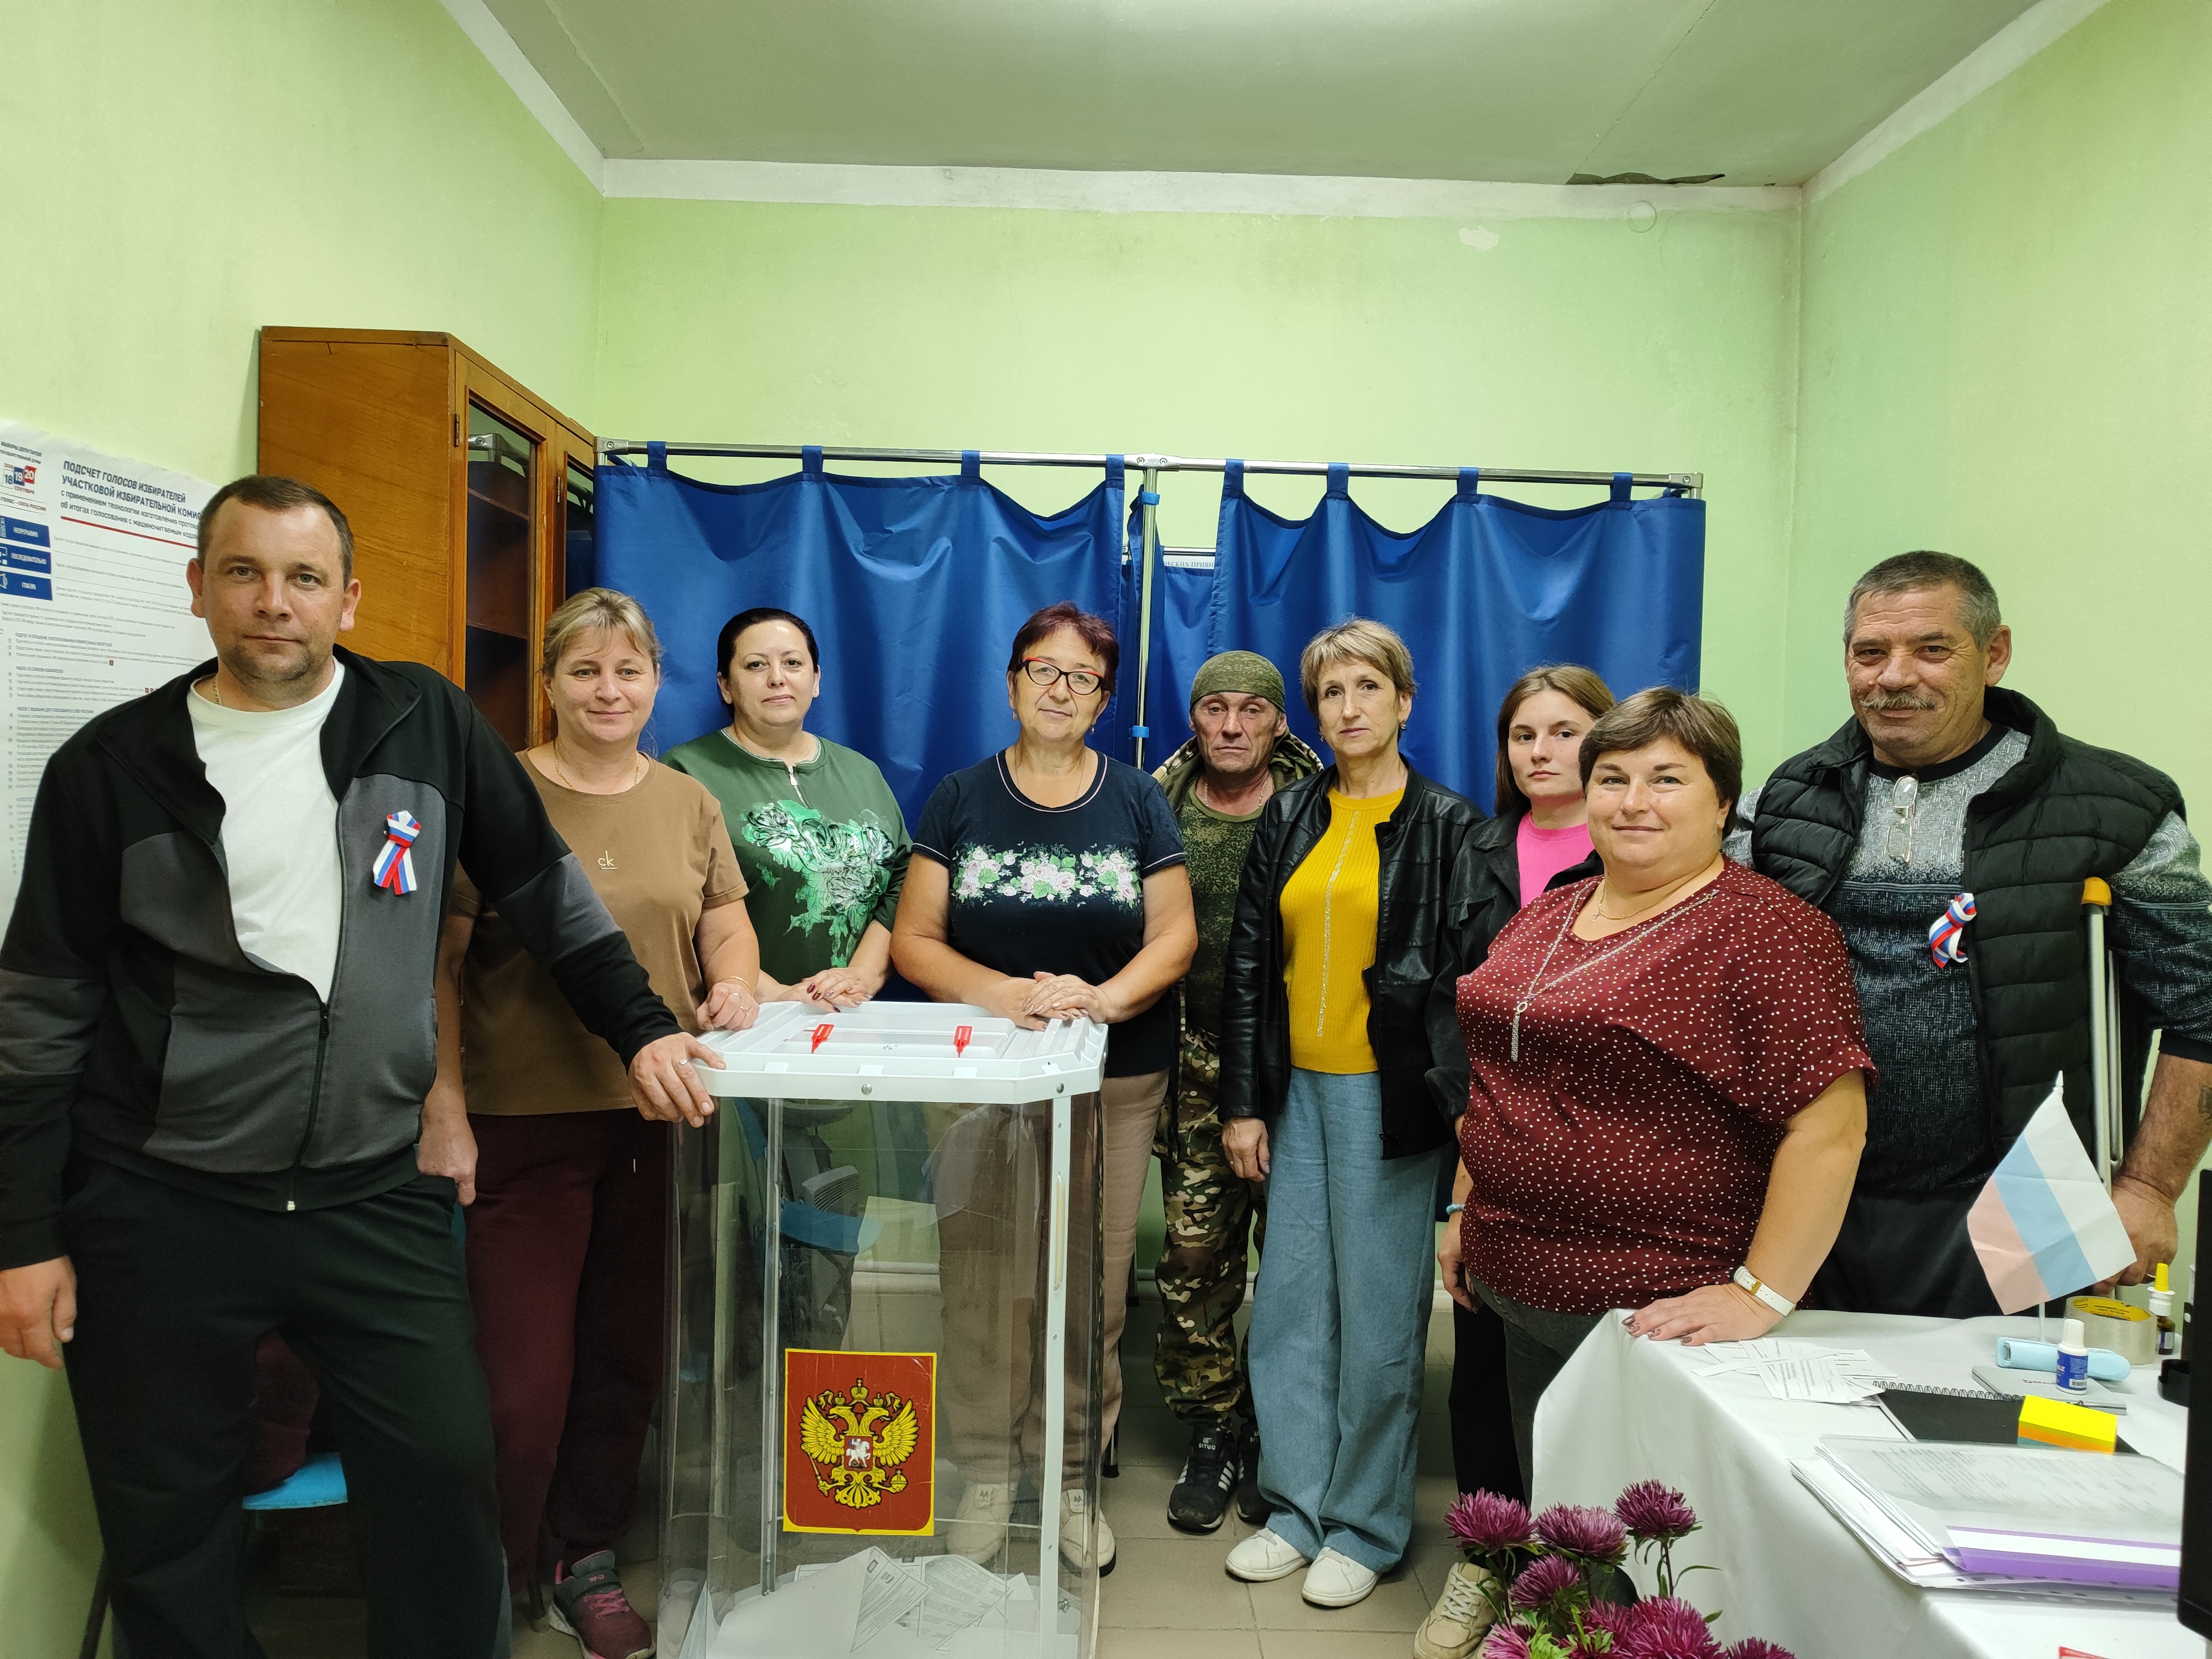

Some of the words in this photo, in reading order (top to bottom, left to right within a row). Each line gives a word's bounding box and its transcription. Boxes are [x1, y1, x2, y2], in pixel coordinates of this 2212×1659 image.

[4, 474, 13, 484] 18
[14, 472, 23, 482] 19
[24, 469, 34, 480] 20
[63, 460, 101, 479] ПОДСЧЕТ
[102, 472, 137, 489] ГОЛОСОВ
[138, 482, 186, 503] ИЗБИРАТЕЛЕЙ
[62, 474, 115, 498] УЧАСТКОВОЙ
[116, 489, 176, 514] ИЗБИРАТЕЛЬНОЙ
[66, 491, 107, 507] применением
[107, 502, 140, 515] технологии
[141, 510, 178, 525] изготовления
[69, 504, 90, 515] итогах
[91, 509, 128, 524] голосования
[133, 519, 182, 536] машиночитаемым
[598, 850, 615, 867] ck
